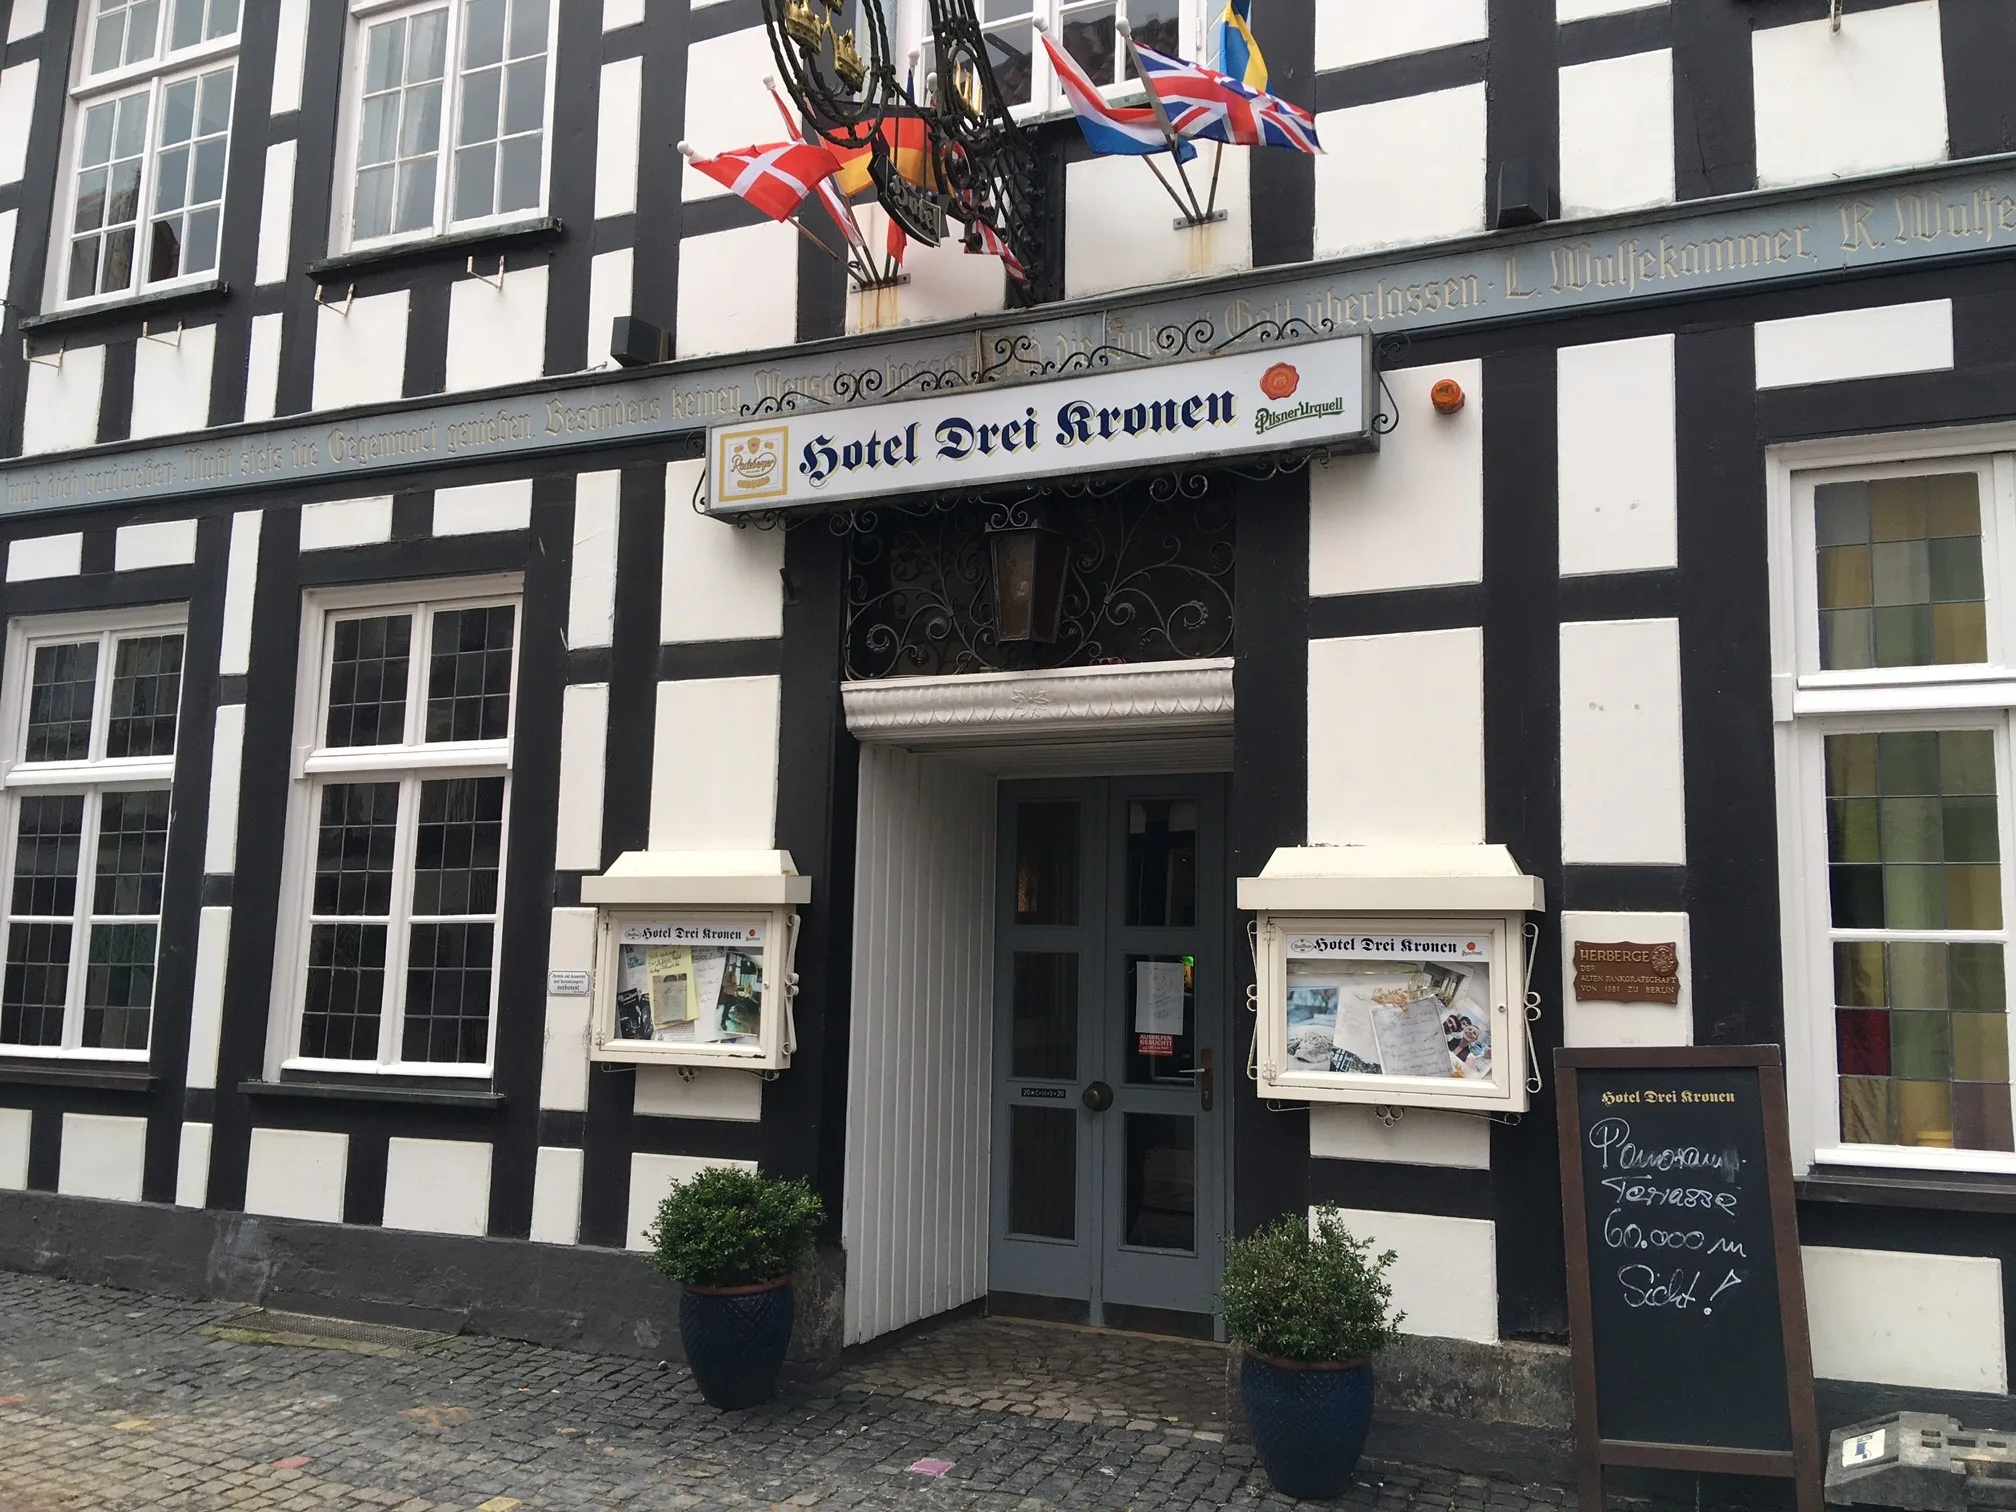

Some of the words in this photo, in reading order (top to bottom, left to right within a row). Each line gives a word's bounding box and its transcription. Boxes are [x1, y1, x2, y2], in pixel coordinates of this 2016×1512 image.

[291, 436, 319, 468] die
[326, 418, 438, 466] Gegenwart
[543, 392, 662, 436] Besonders
[670, 384, 743, 421] keinen
[1307, 273, 1487, 329] überlassen.
[1504, 256, 1544, 301] L.
[1254, 406, 1302, 436] Pilsner
[1298, 396, 1344, 420] Urquell
[800, 427, 918, 488] Hotel
[935, 408, 1039, 460] Drei
[1055, 387, 1239, 447] Kronen
[642, 927, 672, 942] Hotel
[675, 927, 700, 939] Drei
[702, 928, 742, 940] Kronen
[1313, 937, 1356, 953] Hotel
[1361, 937, 1396, 952] Drei
[1400, 938, 1458, 954] Kronen
[1580, 949, 1650, 963] HERBERGE
[1580, 964, 1597, 972] DER
[1580, 974, 1604, 982] ALTEN
[1645, 986, 1675, 994] BERLIN
[1601, 1090, 1640, 1106] Hotel
[1643, 1090, 1677, 1104] Drei
[1681, 1090, 1735, 1104] Kronen
[1604, 1207, 1705, 1249] 60.000
